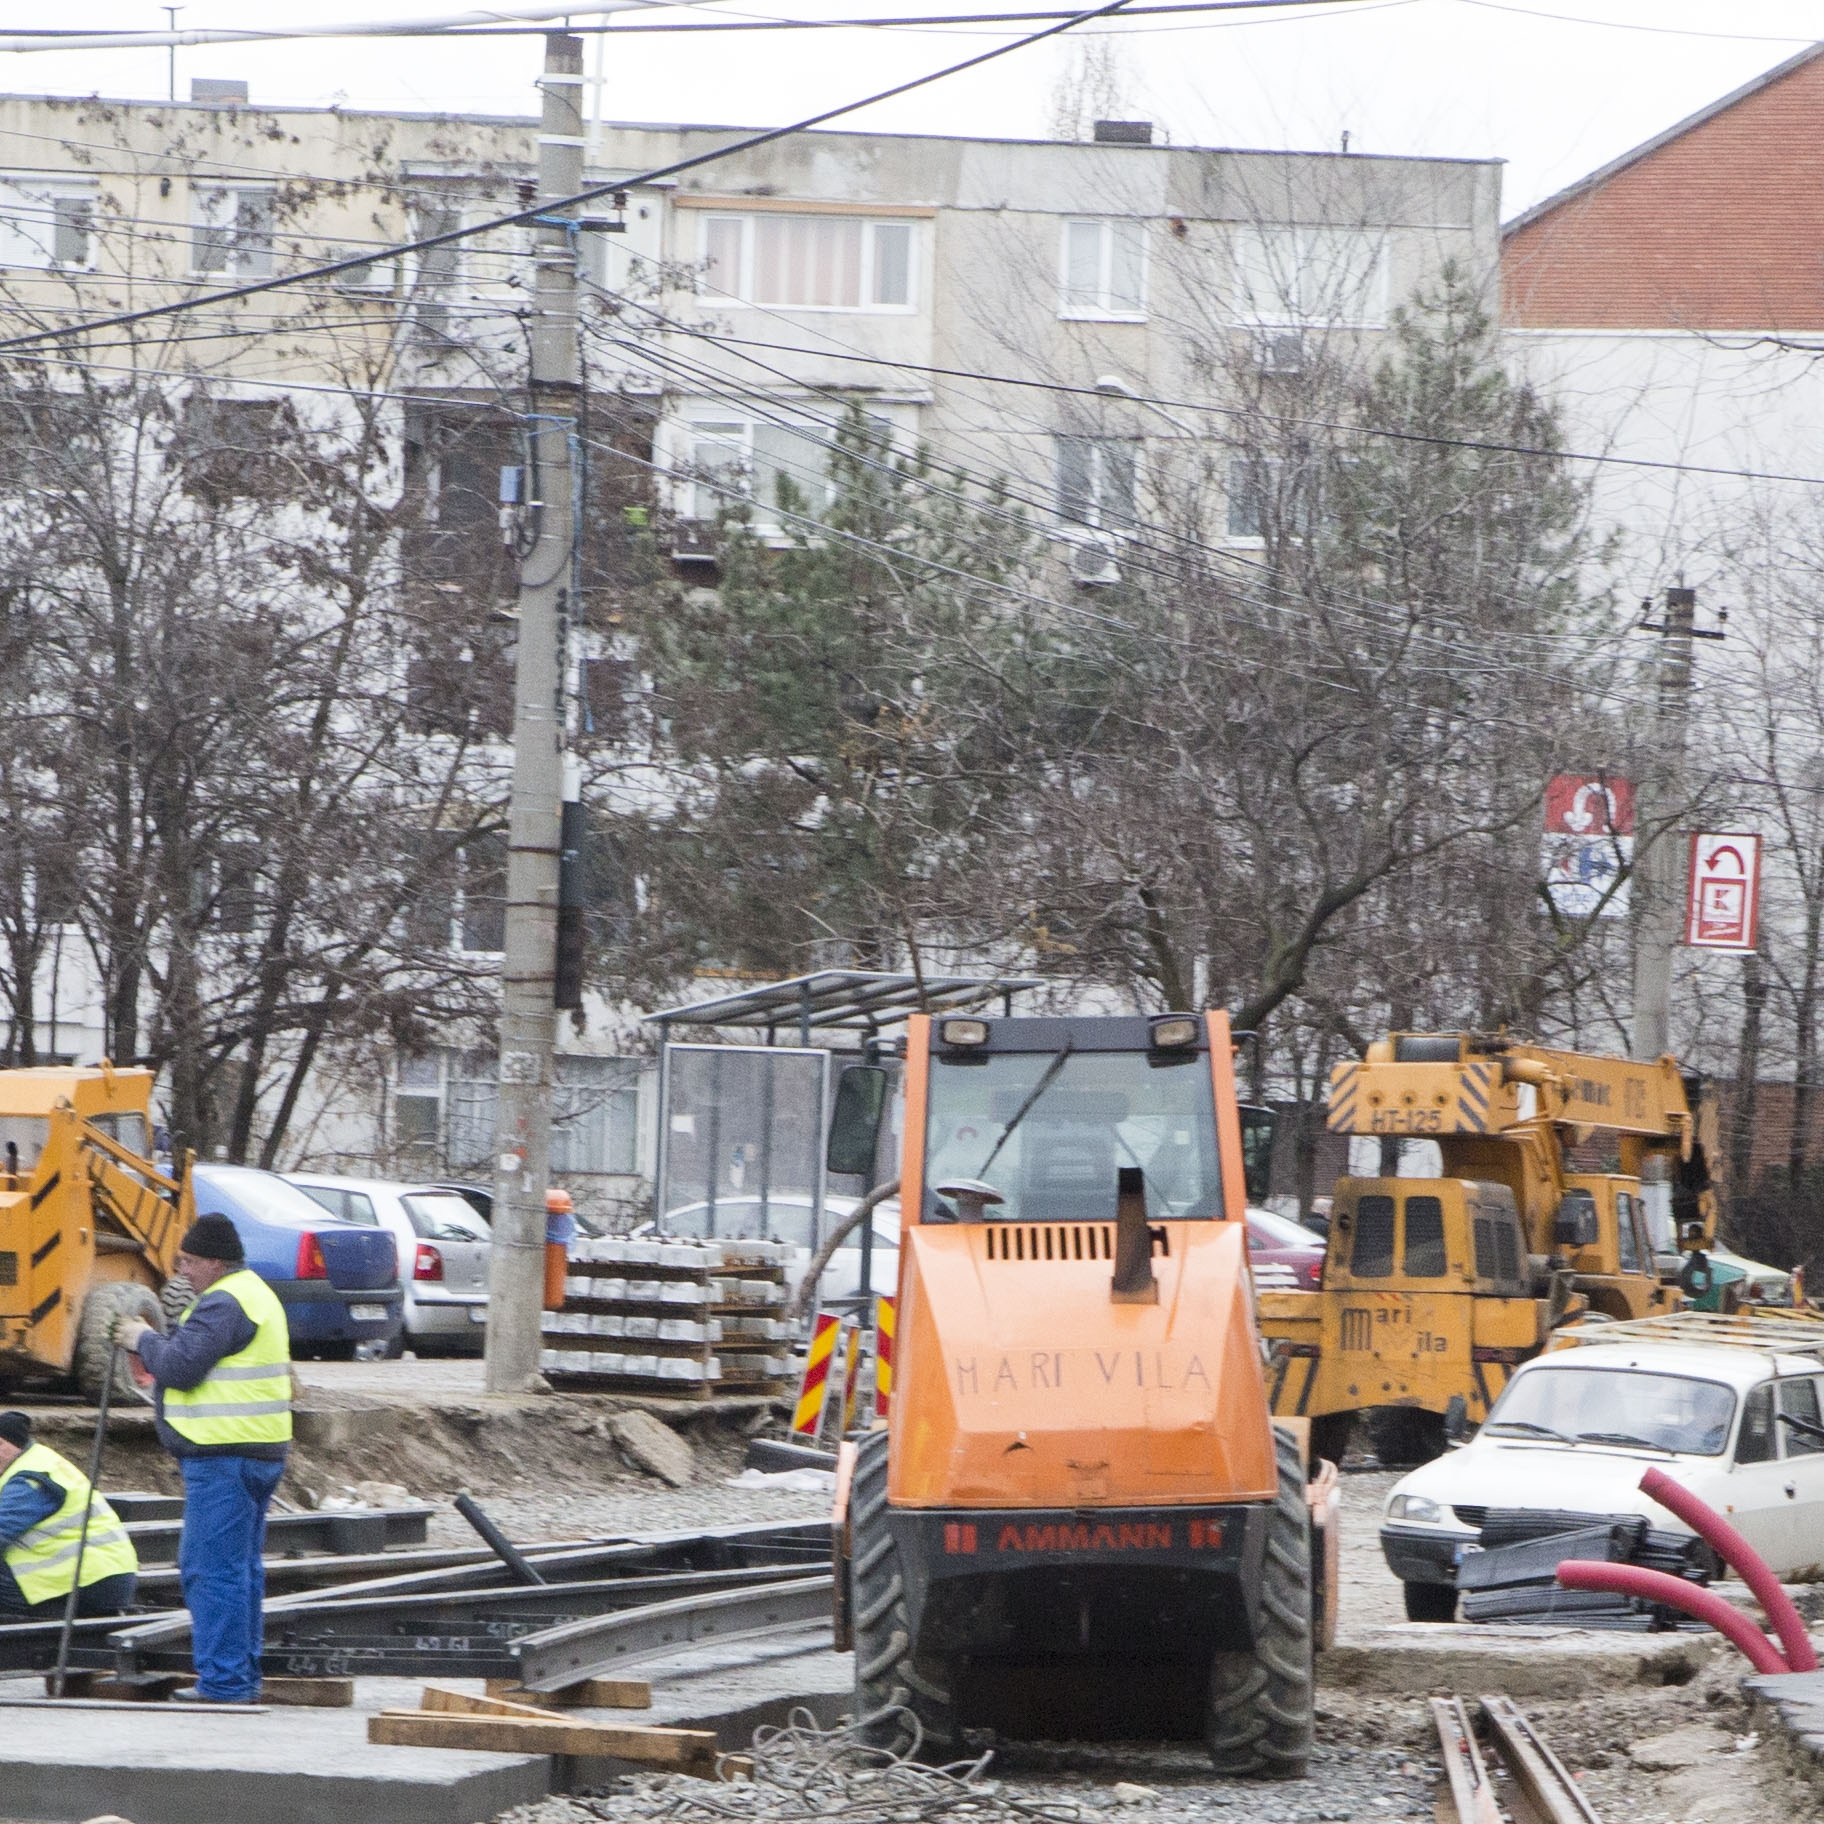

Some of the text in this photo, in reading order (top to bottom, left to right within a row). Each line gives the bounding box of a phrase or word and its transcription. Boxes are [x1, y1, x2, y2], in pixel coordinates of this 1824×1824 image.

[1713, 889, 1731, 911] K
[1372, 1109, 1442, 1134] HT-125
[955, 1350, 1212, 1396] MARI VILA
[996, 1523, 1172, 1552] AMMANN
